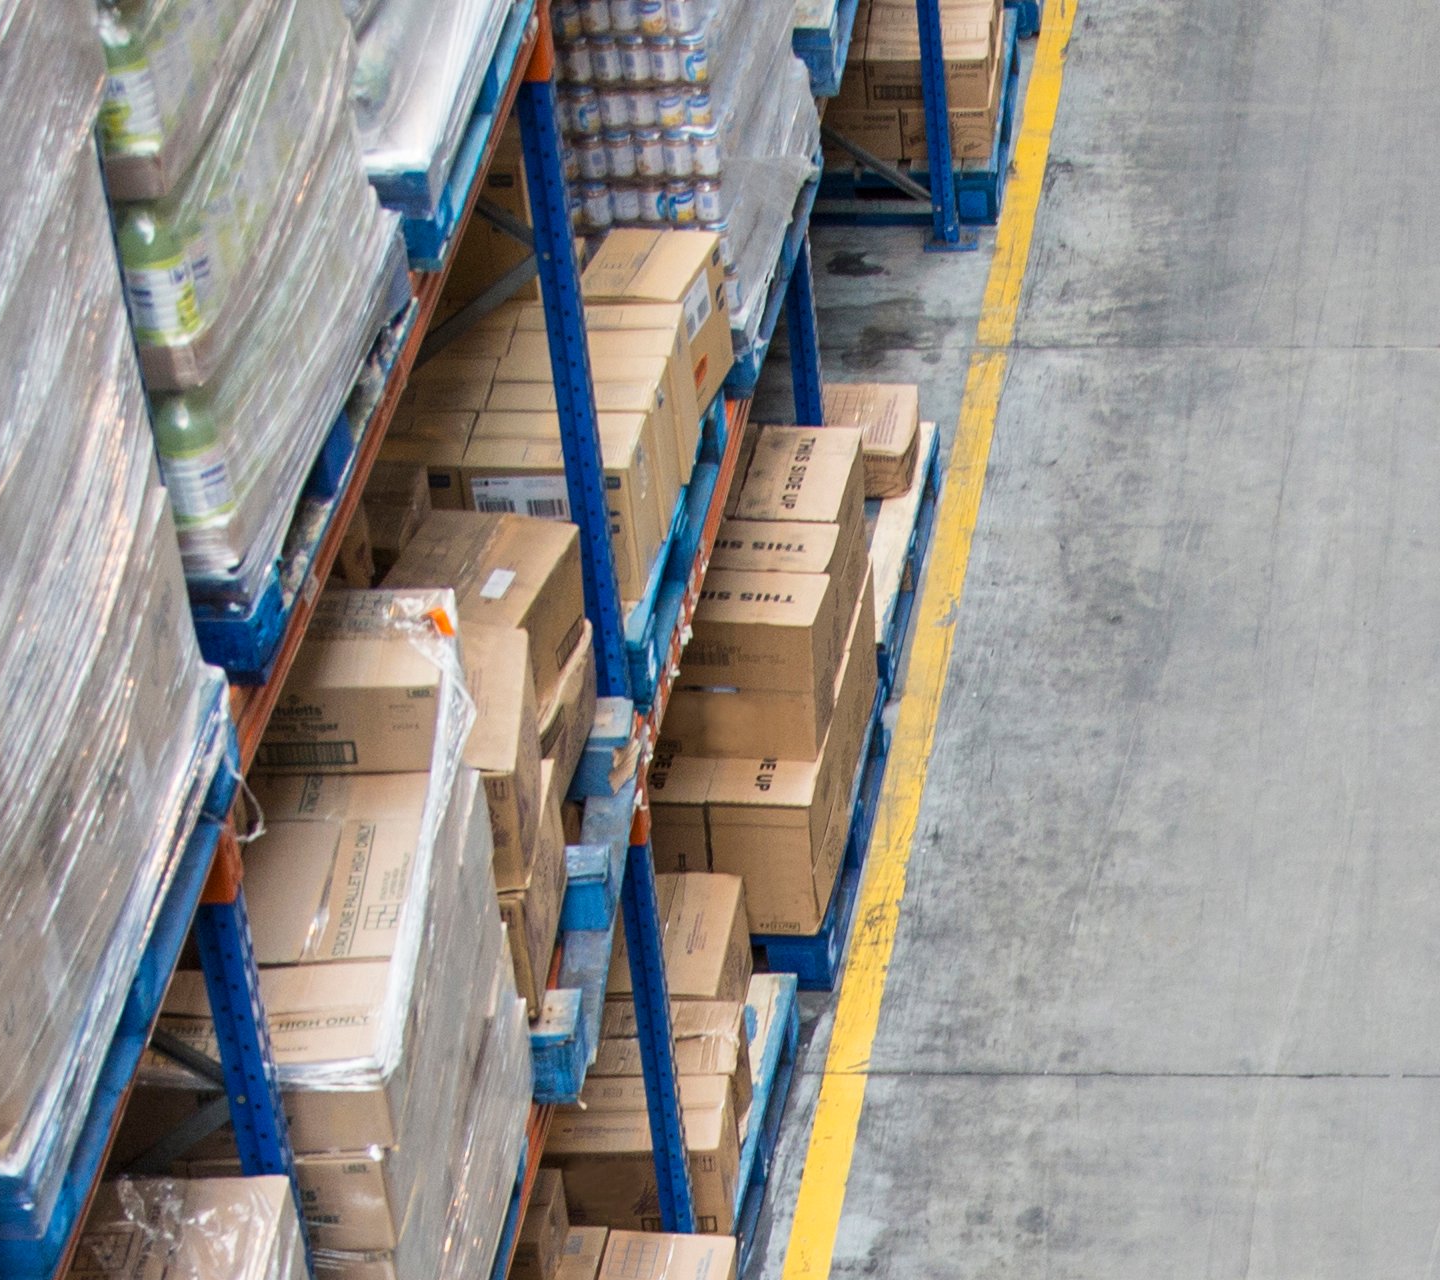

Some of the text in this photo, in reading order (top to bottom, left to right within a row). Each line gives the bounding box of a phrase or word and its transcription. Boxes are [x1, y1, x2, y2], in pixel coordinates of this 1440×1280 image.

[780, 437, 816, 510] THIS SIDE UP
